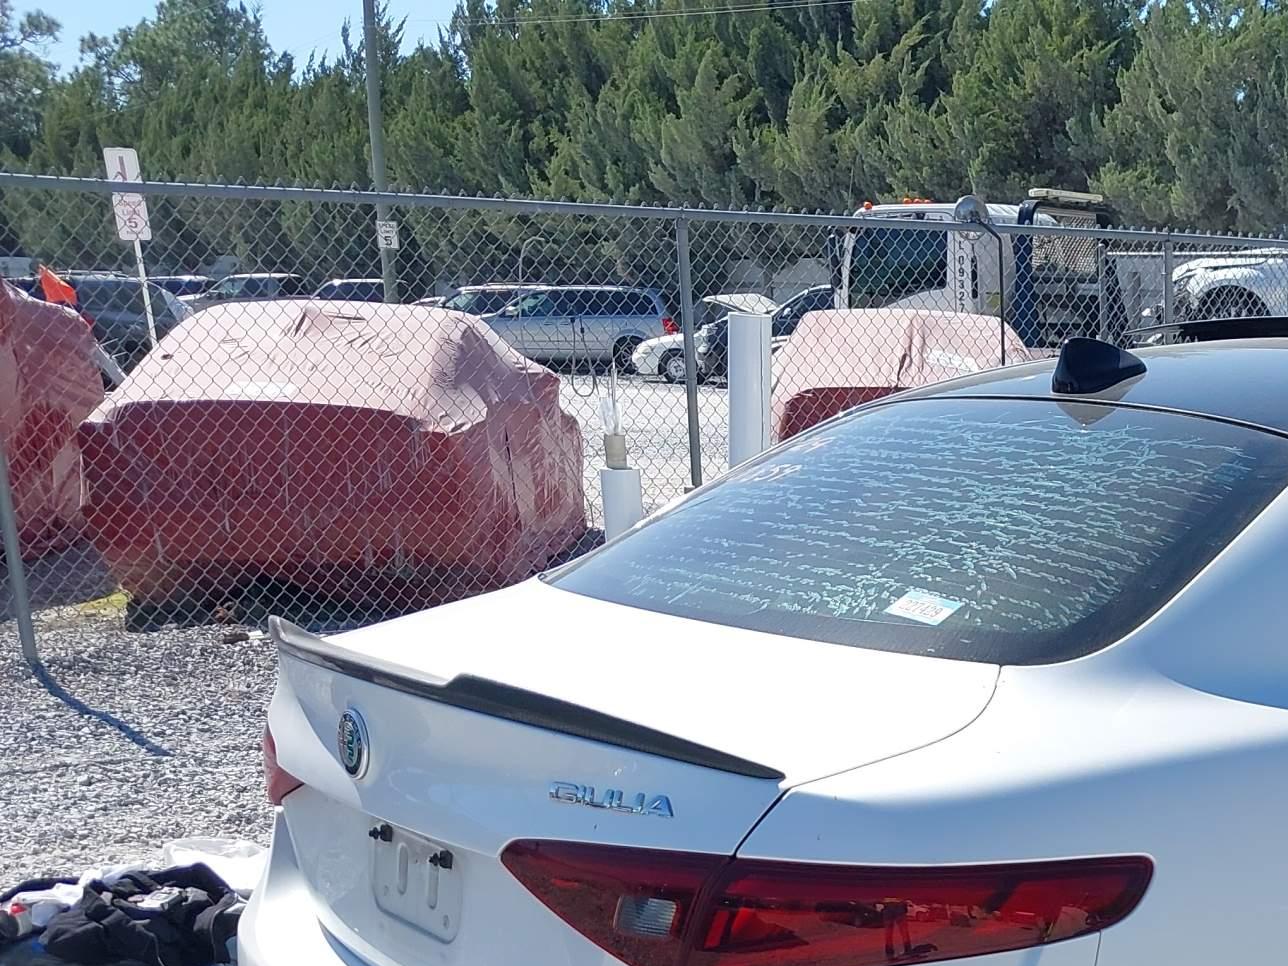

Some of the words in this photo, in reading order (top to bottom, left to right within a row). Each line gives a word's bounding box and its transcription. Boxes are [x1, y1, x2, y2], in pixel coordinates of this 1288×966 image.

[127, 217, 138, 229] 5
[383, 235, 393, 246] 5
[549, 781, 674, 818] GIULIA
